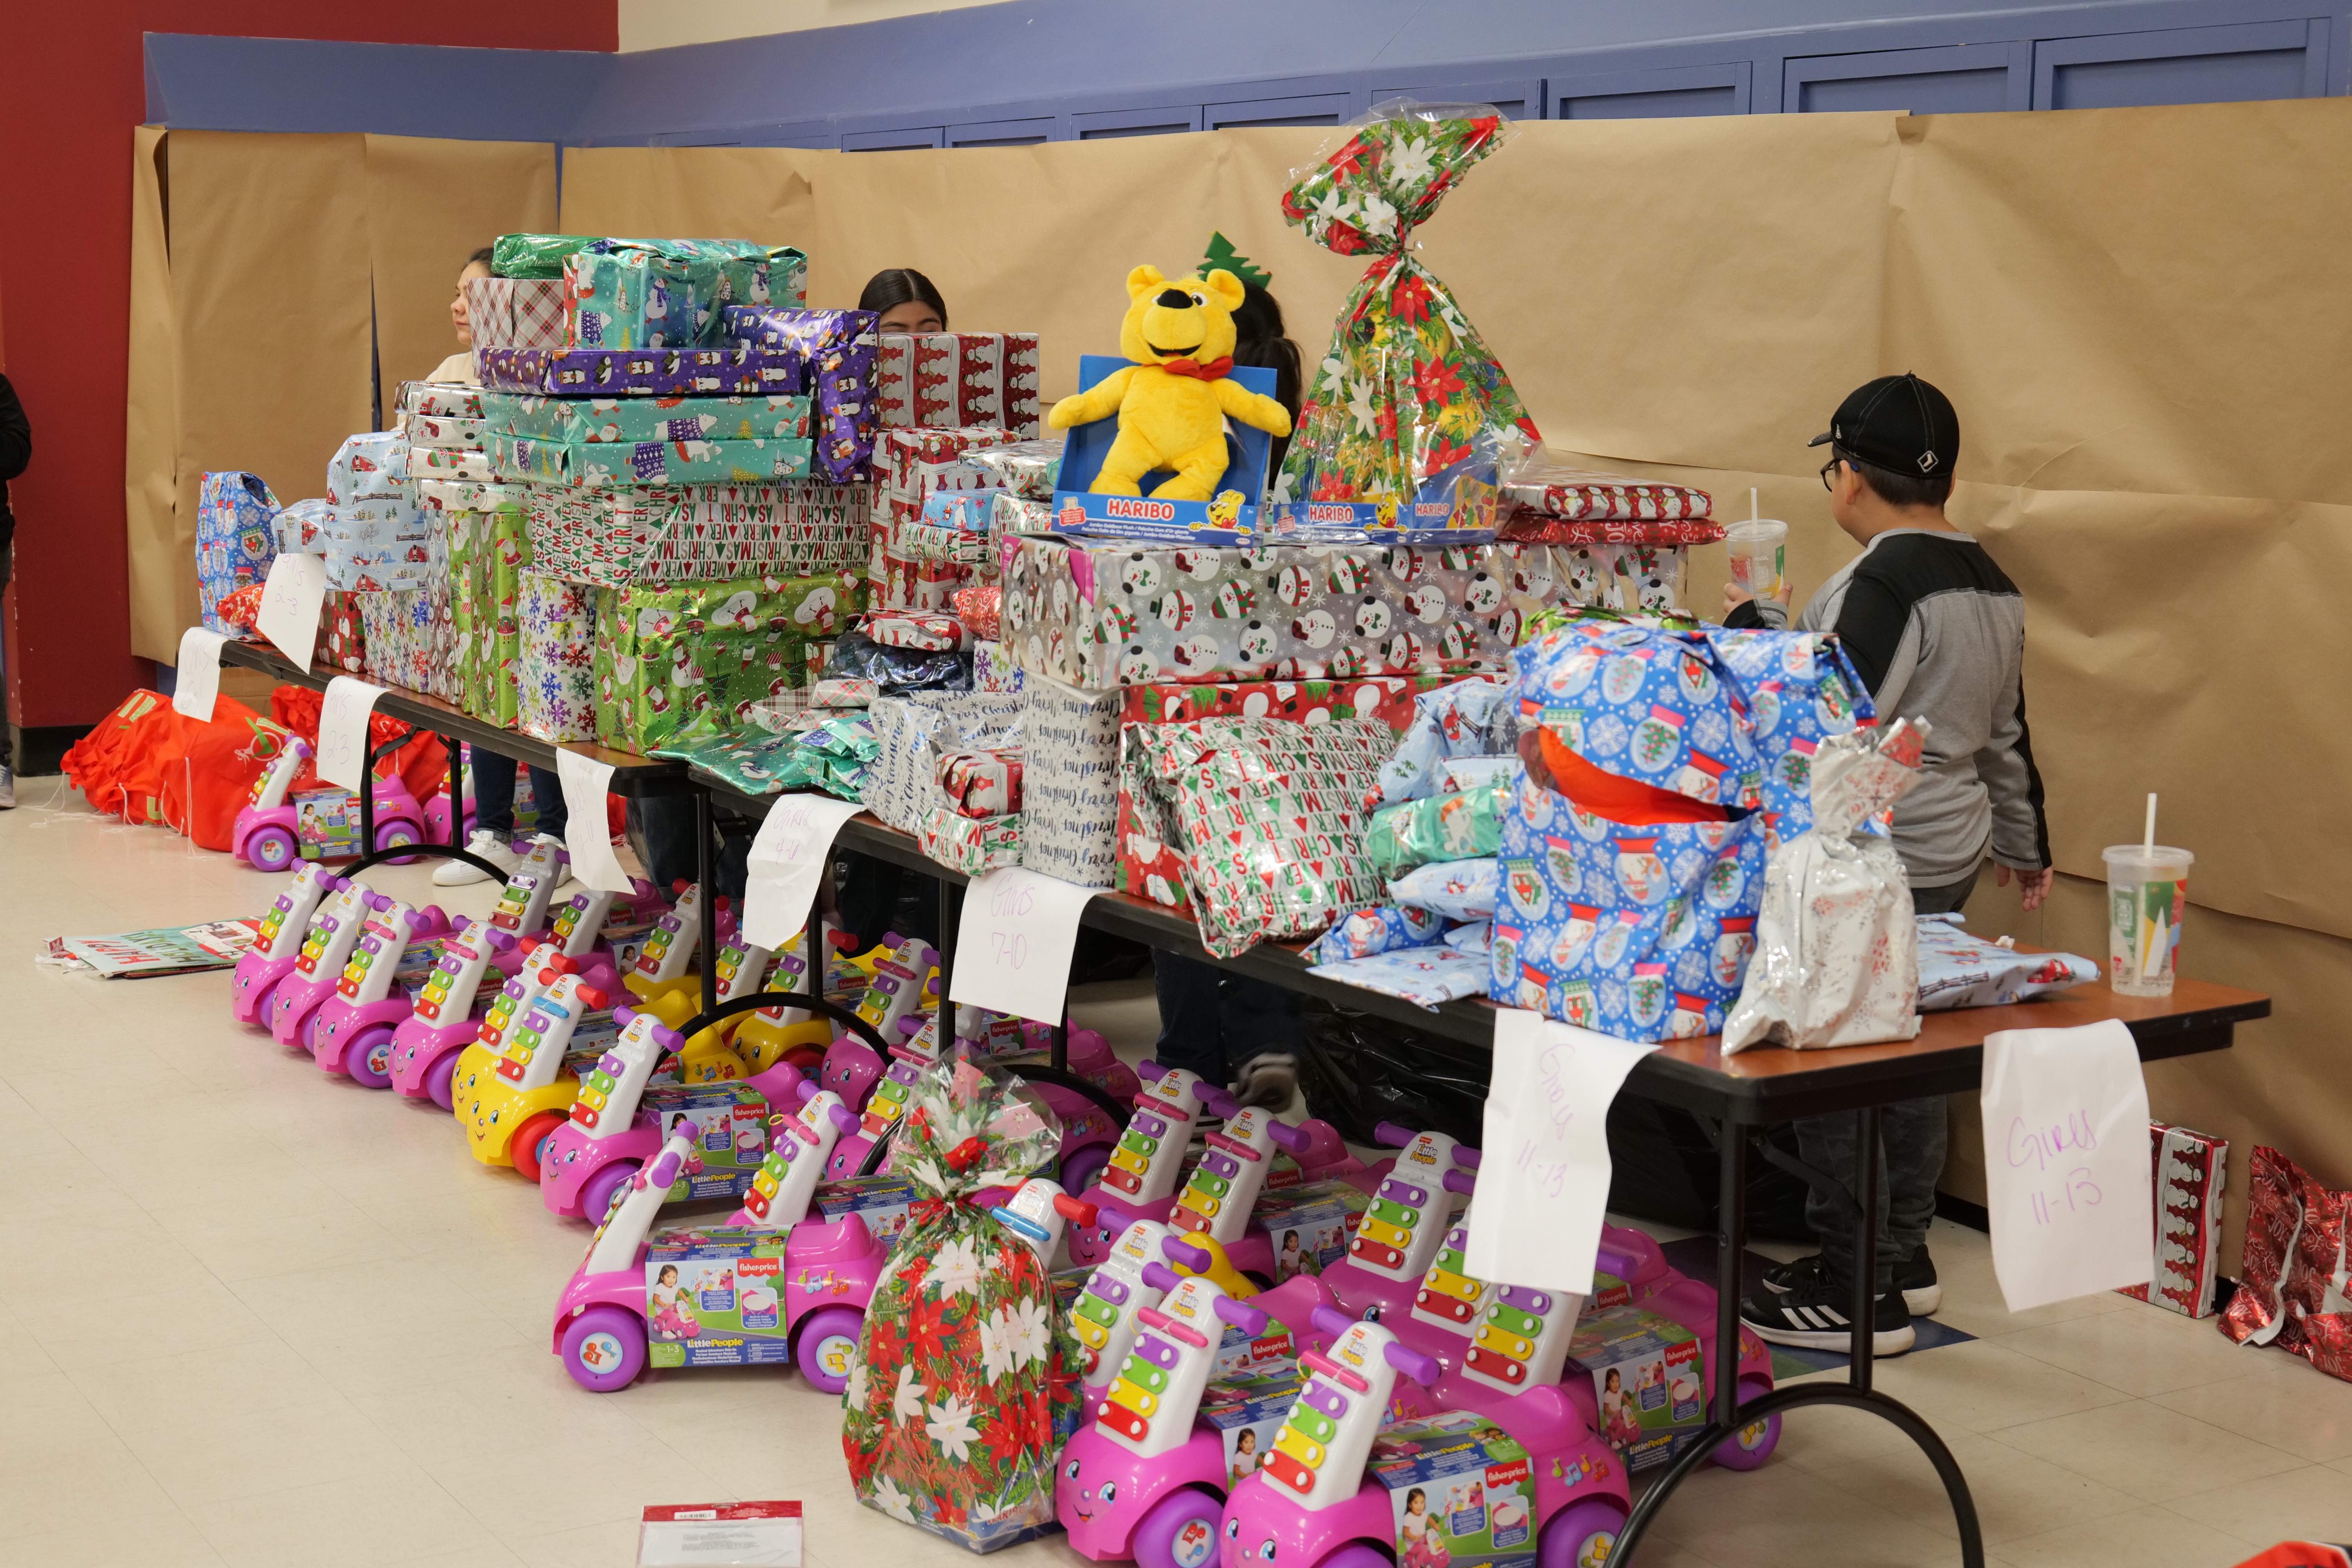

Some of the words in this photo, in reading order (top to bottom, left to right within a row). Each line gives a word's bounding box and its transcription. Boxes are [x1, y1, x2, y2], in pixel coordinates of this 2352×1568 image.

[758, 505, 821, 524] CHRISTMAS
[1108, 499, 1174, 520] HARIBO
[1309, 505, 1354, 523] HARIBO
[1415, 503, 1450, 516] HARIBO
[706, 524, 728, 540] VERY
[737, 524, 771, 540] MERRY
[813, 525, 844, 541] MERRY
[562, 532, 571, 572] MERRY
[726, 542, 790, 560] CHRISTMAS
[800, 543, 861, 561] CHRISTMAS
[603, 543, 613, 582] MERRY
[661, 561, 682, 577] VERY
[692, 561, 726, 578] MERRY
[1315, 735, 1361, 752] MERRY
[1290, 771, 1338, 790] MERRY
[1061, 819, 1118, 841] hristmas
[1079, 848, 1117, 867] erry
[894, 951, 909, 963] People
[898, 945, 912, 956] Little
[991, 931, 1027, 970] 7-10
[477, 982, 503, 992] isher-price
[992, 1024, 1018, 1033] fisher-price
[914, 1038, 931, 1051] People
[920, 1031, 934, 1044] Little
[1159, 1086, 1180, 1098] People
[1165, 1077, 1182, 1091] Little
[735, 1108, 765, 1116] fisher-price
[1237, 1118, 1255, 1132] Little
[1230, 1127, 1252, 1140] People
[1409, 1151, 1437, 1165] People
[1415, 1143, 1438, 1157] Little
[1516, 1138, 1568, 1198] 11-13
[1269, 1174, 1299, 1186] fisher-price
[2030, 1167, 2103, 1225] 11-13
[1127, 1233, 1149, 1251] Little
[1122, 1243, 1146, 1259] People
[739, 1261, 777, 1273] fisher-price
[1176, 1290, 1200, 1309] Little
[1599, 1292, 1630, 1305] fisher-price
[1170, 1301, 1197, 1318] People
[1253, 1341, 1289, 1356] fisher-price
[1347, 1337, 1368, 1357] Little
[1666, 1346, 1697, 1361] fisher-price
[1338, 1347, 1365, 1368] People
[1487, 1467, 1526, 1482] fisher-price
